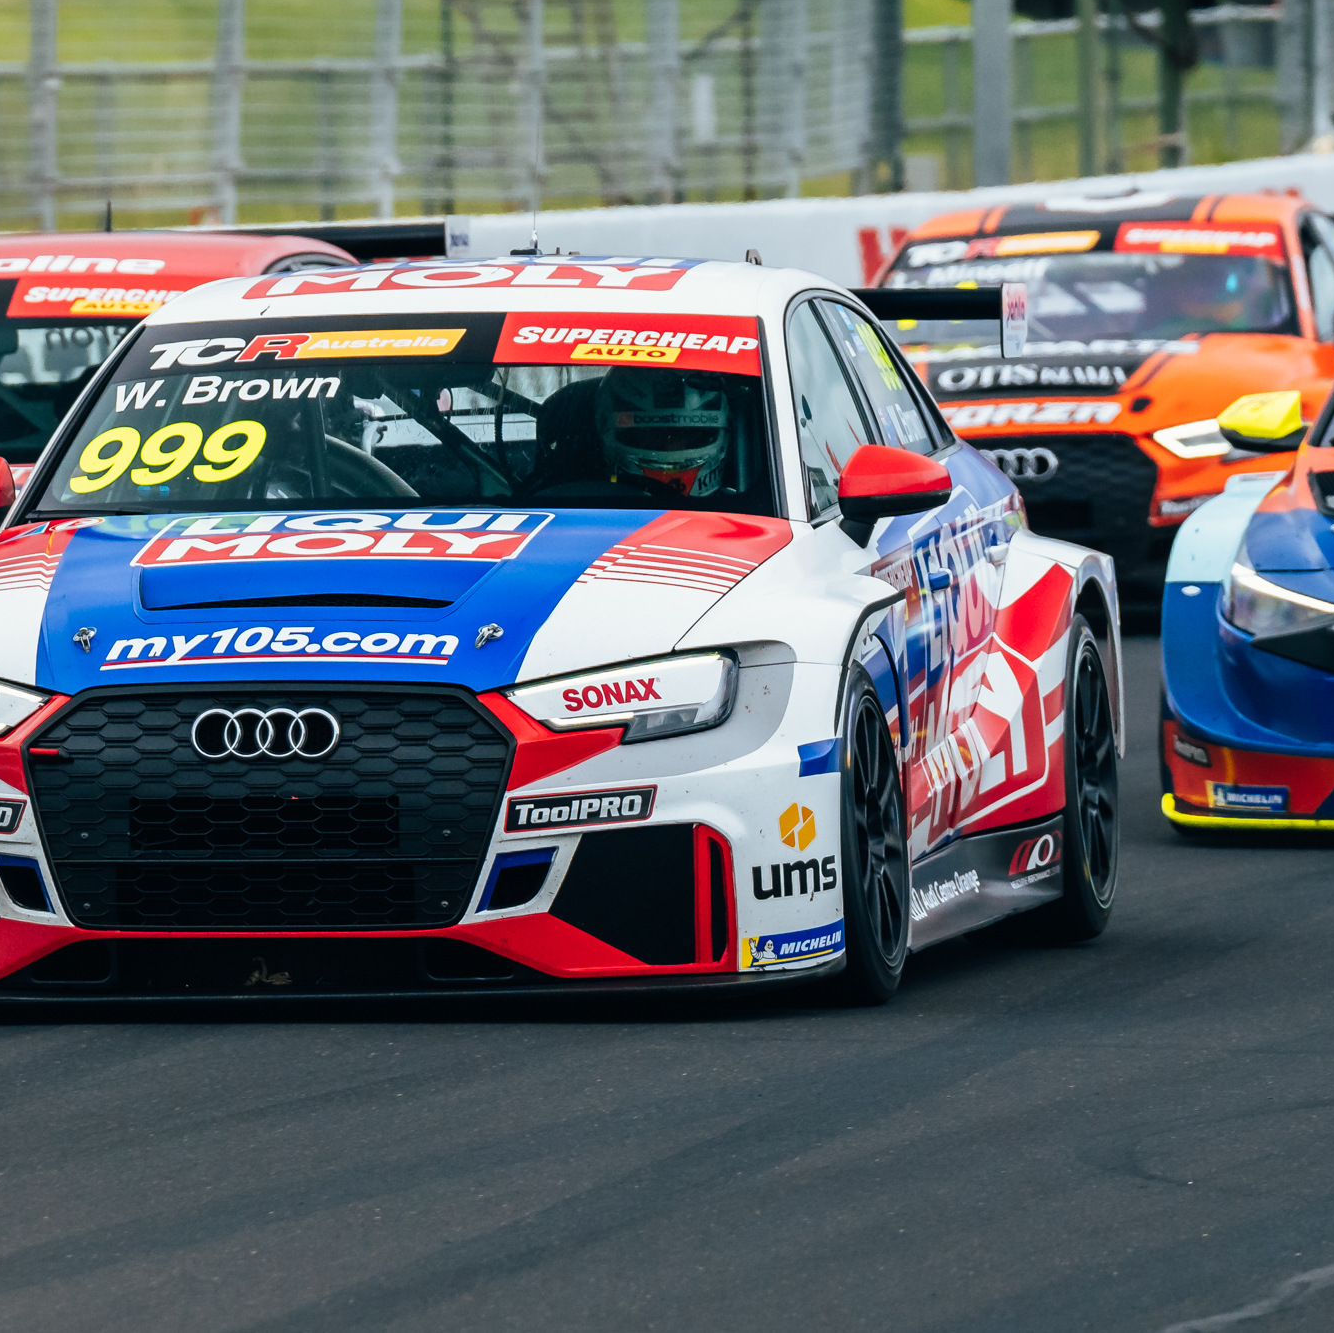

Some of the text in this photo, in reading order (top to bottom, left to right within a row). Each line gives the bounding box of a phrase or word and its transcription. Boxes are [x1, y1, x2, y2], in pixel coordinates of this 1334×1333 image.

[23, 286, 185, 303] SUPERCHE
[265, 266, 671, 297] MOLY
[82, 302, 150, 311] AUTO
[149, 332, 312, 370] TCR
[308, 334, 450, 351] Australia
[512, 325, 759, 354] SUPERCHEAP
[584, 346, 667, 359] AUTO
[115, 374, 341, 413] W. Brown
[69, 419, 268, 495] 999
[181, 512, 533, 534] LIQUI
[156, 531, 525, 562] MOLY
[105, 625, 460, 663] my105.com
[562, 677, 662, 713] SONAX
[514, 793, 644, 826] ToolPRO
[752, 854, 838, 902] ums
[953, 869, 981, 894] Orange
[779, 929, 843, 956] MICHELIN
